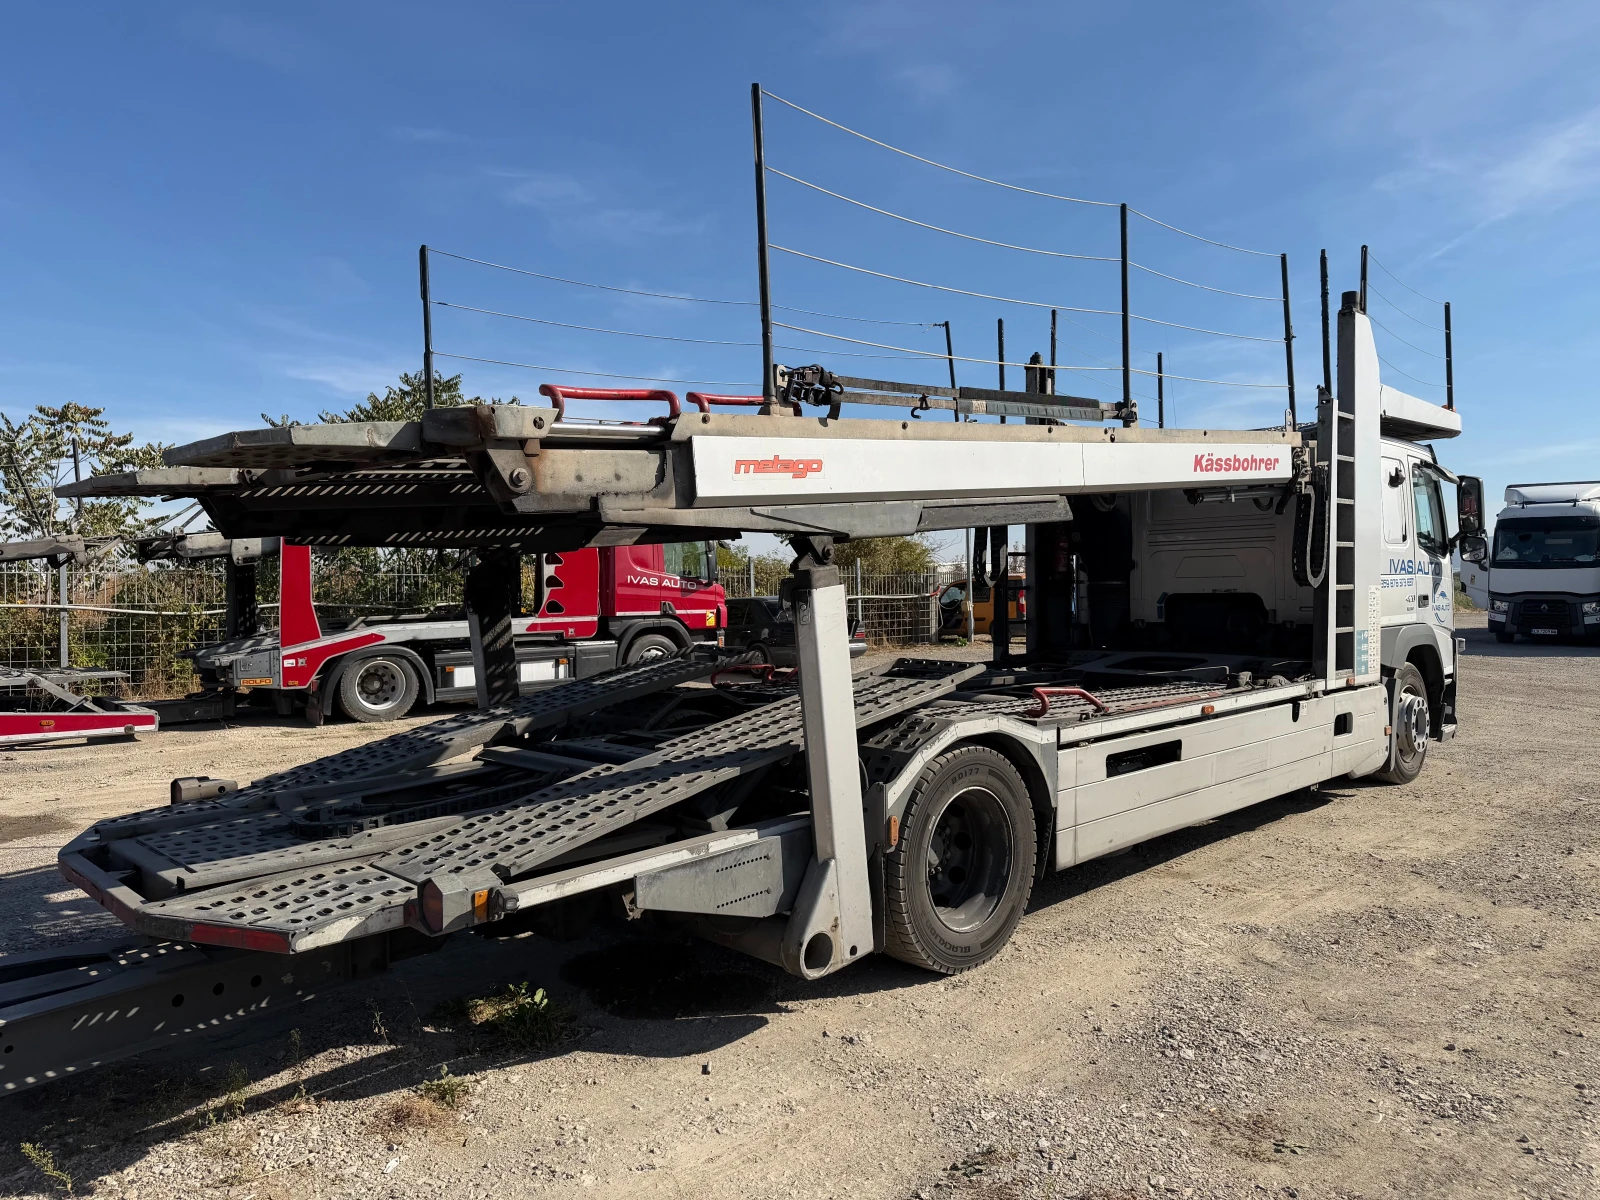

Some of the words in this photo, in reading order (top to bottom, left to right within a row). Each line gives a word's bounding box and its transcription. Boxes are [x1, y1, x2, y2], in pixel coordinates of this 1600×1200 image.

[734, 455, 823, 479] metago
[1193, 453, 1280, 472] Kässbohrer
[1389, 558, 1414, 575] IVAS
[1416, 560, 1440, 576] AUTO
[627, 575, 659, 586] IVAS
[661, 578, 697, 590] AUTO
[925, 920, 971, 954] BLACKLION
